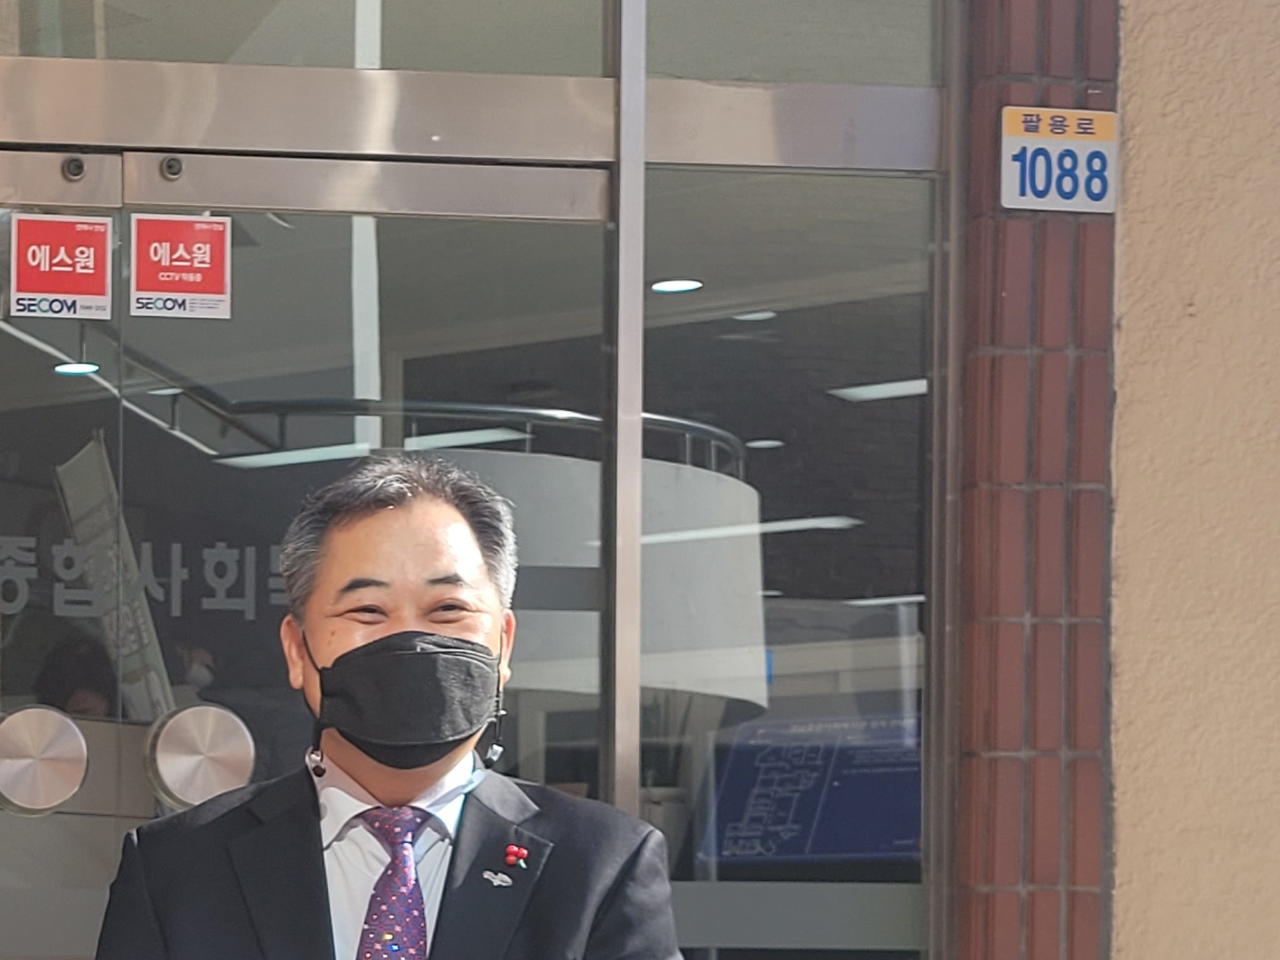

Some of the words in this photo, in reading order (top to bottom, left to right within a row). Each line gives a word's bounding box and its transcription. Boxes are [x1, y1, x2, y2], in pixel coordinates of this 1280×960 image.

[1022, 113, 1096, 135] 팔용로
[1011, 146, 1108, 202] 1088
[27, 244, 95, 273] 에스원
[149, 242, 211, 268] 에스원
[16, 297, 77, 315] SECOM
[136, 297, 186, 312] SECOM
